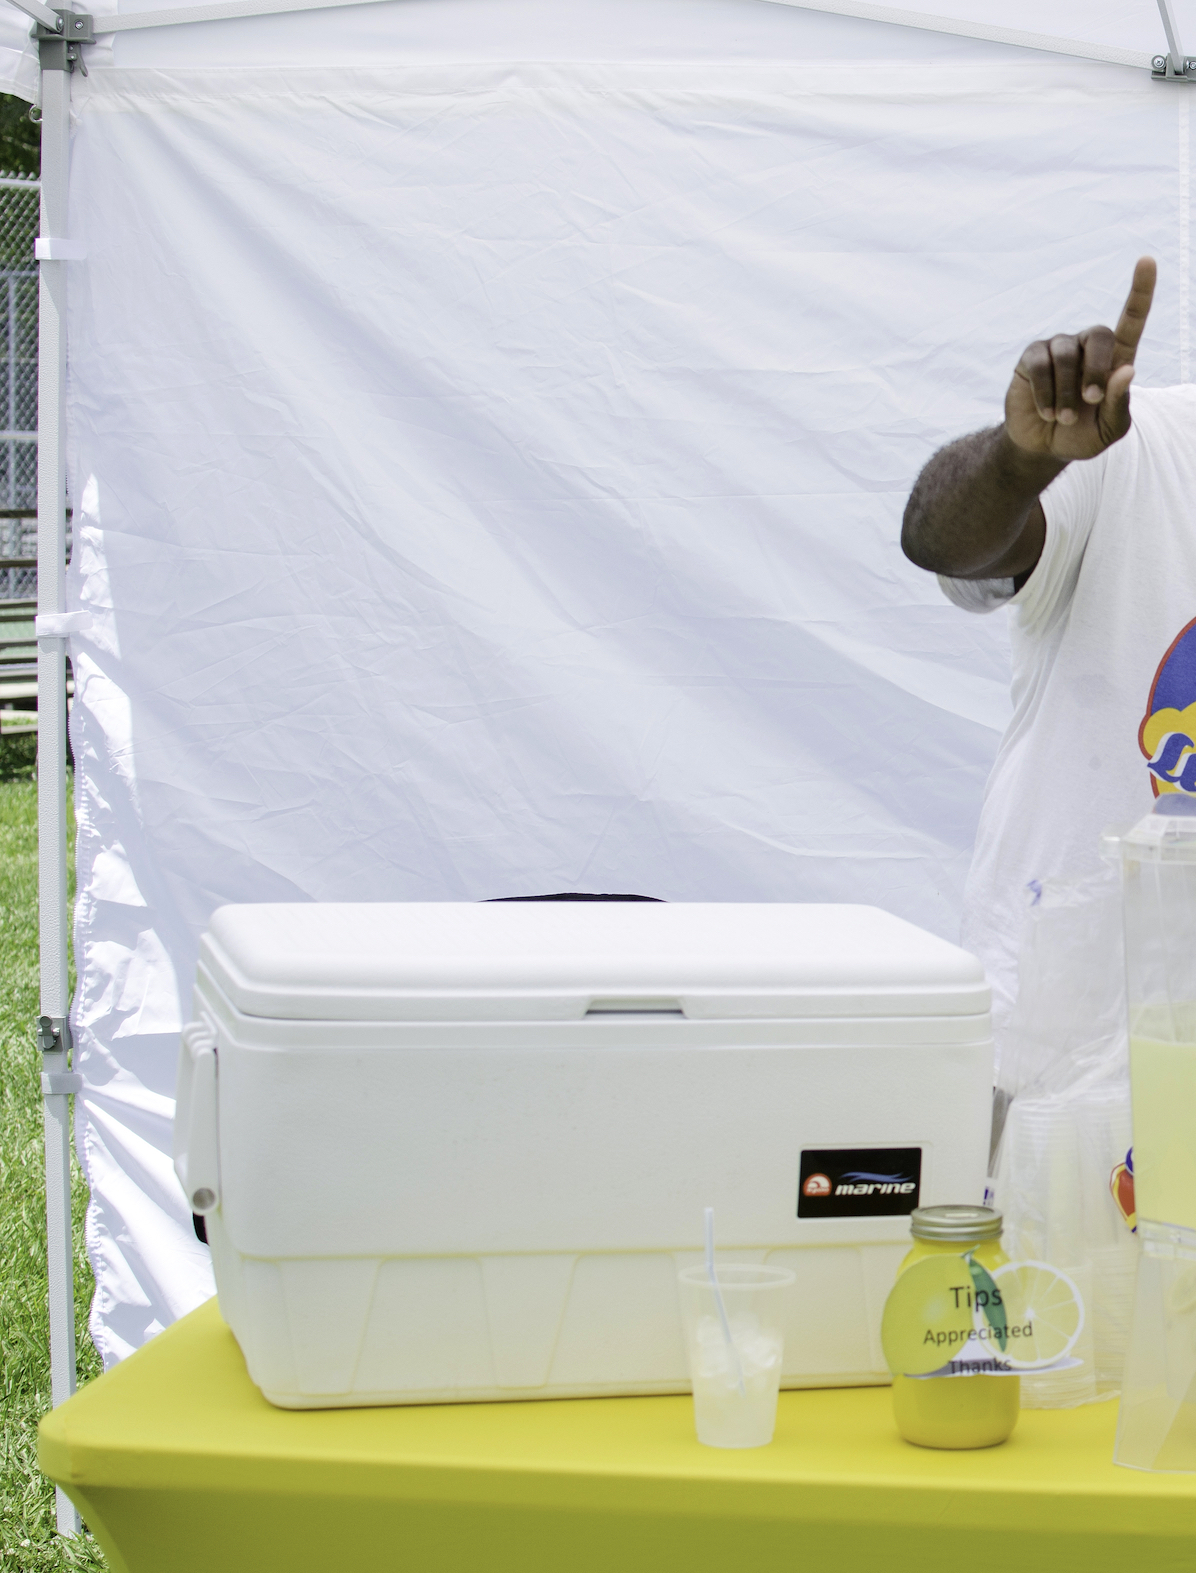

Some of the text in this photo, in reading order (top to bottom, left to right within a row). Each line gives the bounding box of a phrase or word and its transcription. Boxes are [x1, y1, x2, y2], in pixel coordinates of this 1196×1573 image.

[835, 1182, 916, 1196] marine
[949, 1285, 1003, 1313] Tips
[923, 1320, 1033, 1346] Appreciated
[948, 1356, 1013, 1374] Thanks
